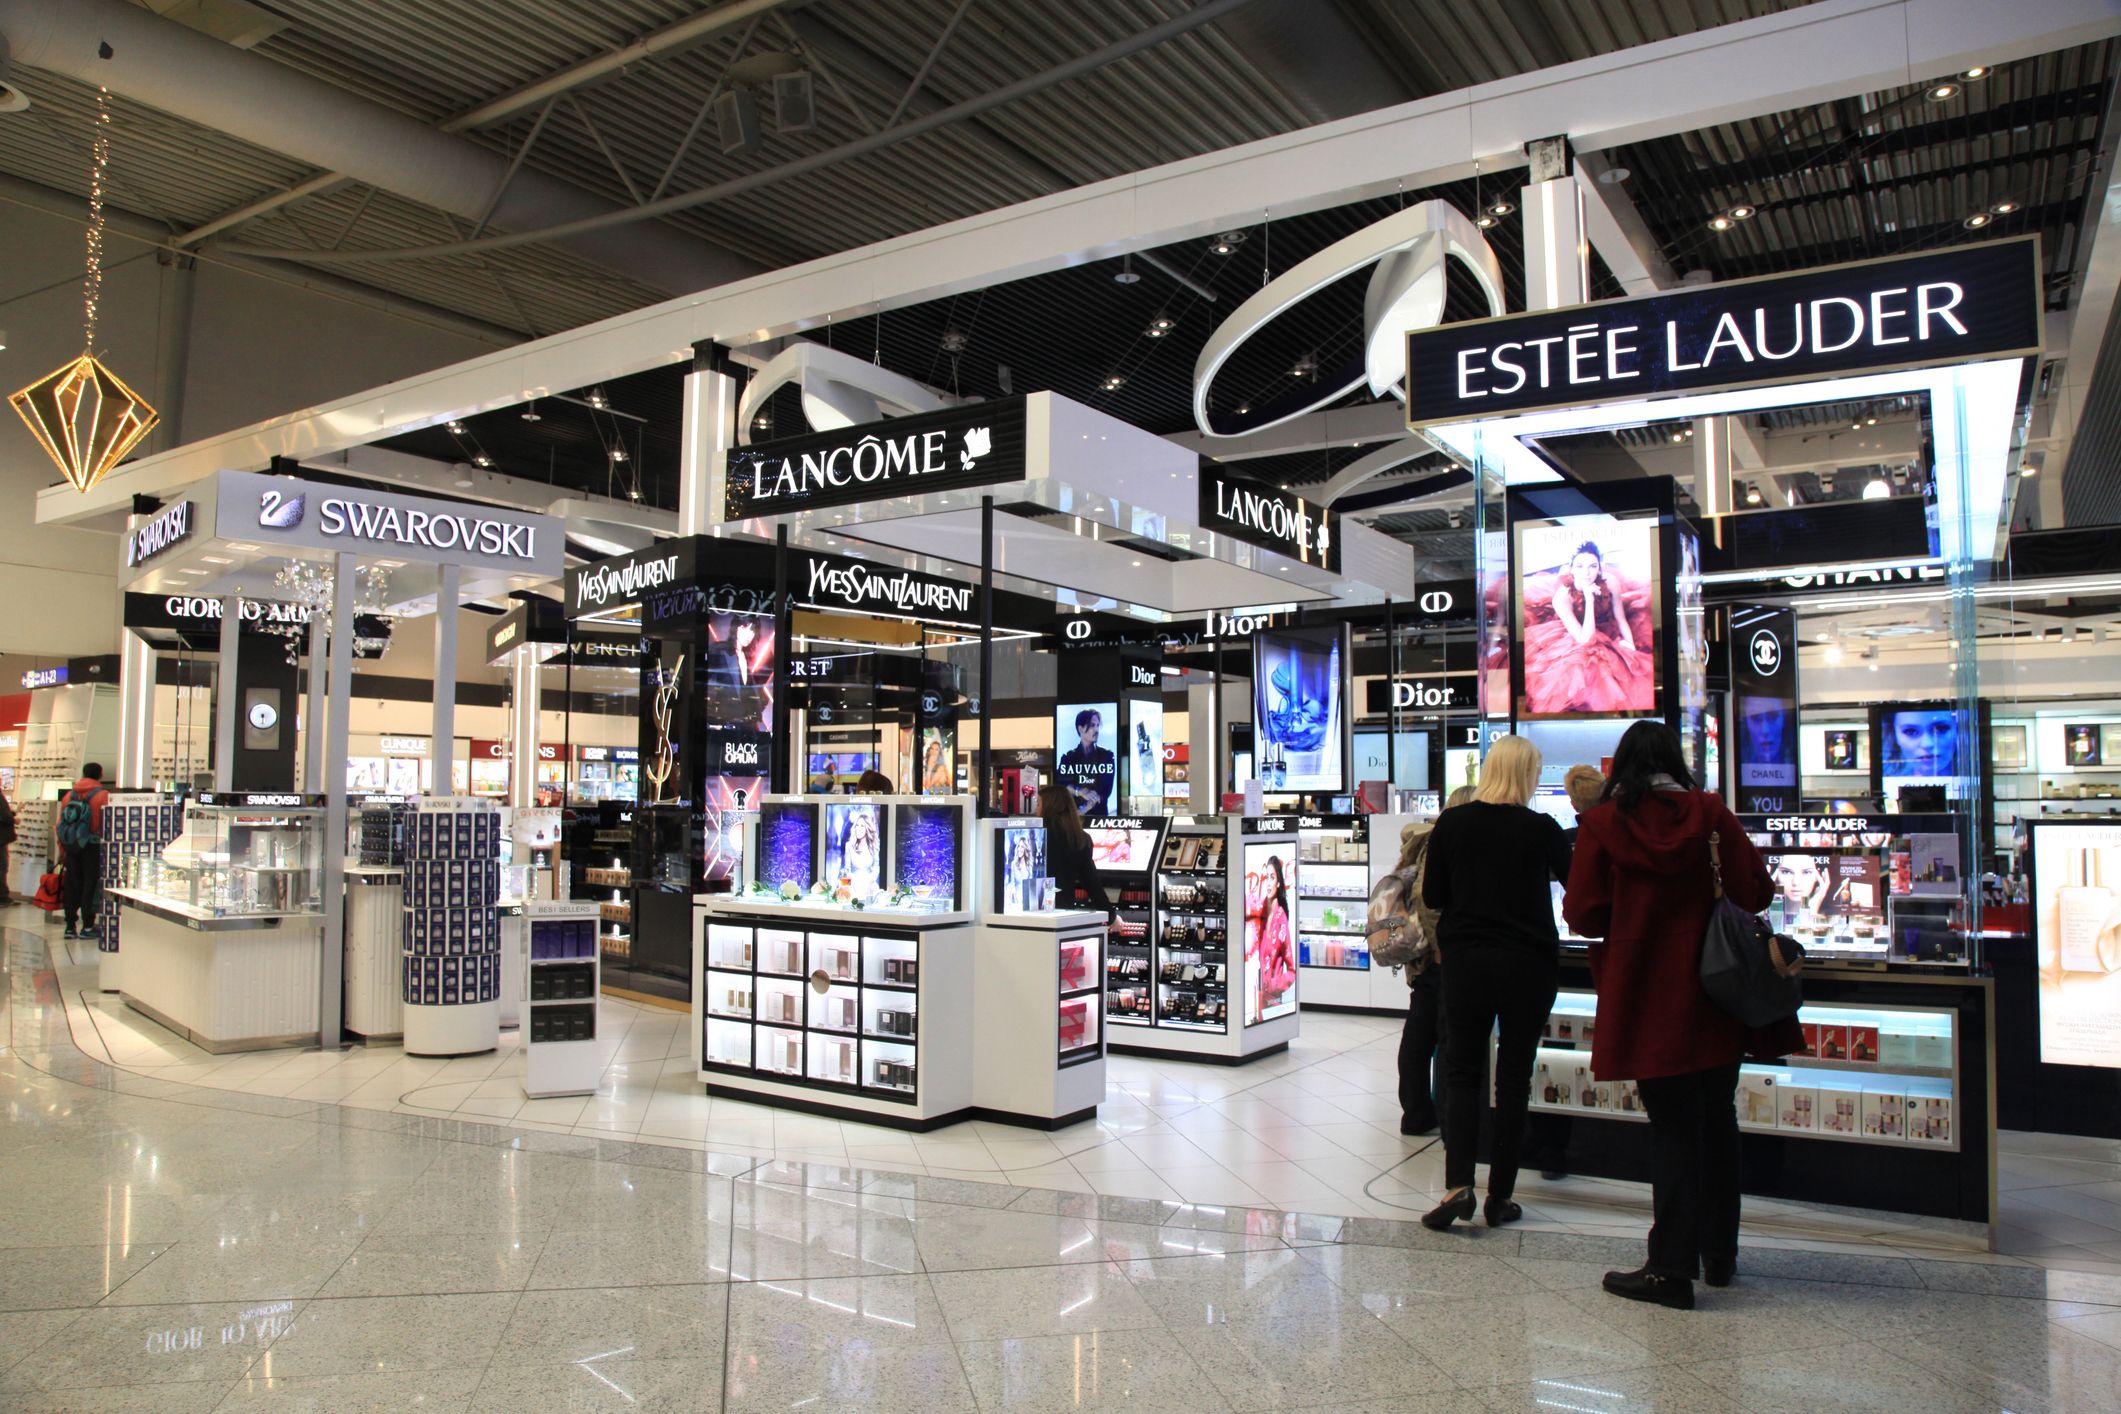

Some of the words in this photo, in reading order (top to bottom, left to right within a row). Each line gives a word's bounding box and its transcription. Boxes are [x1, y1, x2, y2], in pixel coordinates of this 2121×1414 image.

[1667, 282, 1968, 370] LAUDER
[752, 430, 946, 500] LANCÔME
[1216, 480, 1314, 550] LANCÔME
[138, 500, 188, 561] SWAROVSKI
[320, 499, 536, 558] SWAROVSKI
[166, 597, 260, 620] GIORIO
[1203, 613, 1268, 638] Dior
[1131, 665, 1156, 685] Dior
[1392, 682, 1455, 707] Dior
[380, 738, 427, 750] CLINIQUE
[725, 742, 757, 754] BLACK
[725, 753, 758, 764] OPIUM
[1368, 756, 1388, 768] Dio
[1060, 763, 1114, 774] SAUVAGE
[1751, 769, 1784, 779] CHANEL
[1079, 774, 1096, 784] Dior
[247, 795, 300, 806] SWAROVSKI
[1752, 797, 1783, 812] YOU
[1810, 818, 1868, 831] LAUDER
[559, 905, 591, 913] SELLERS
